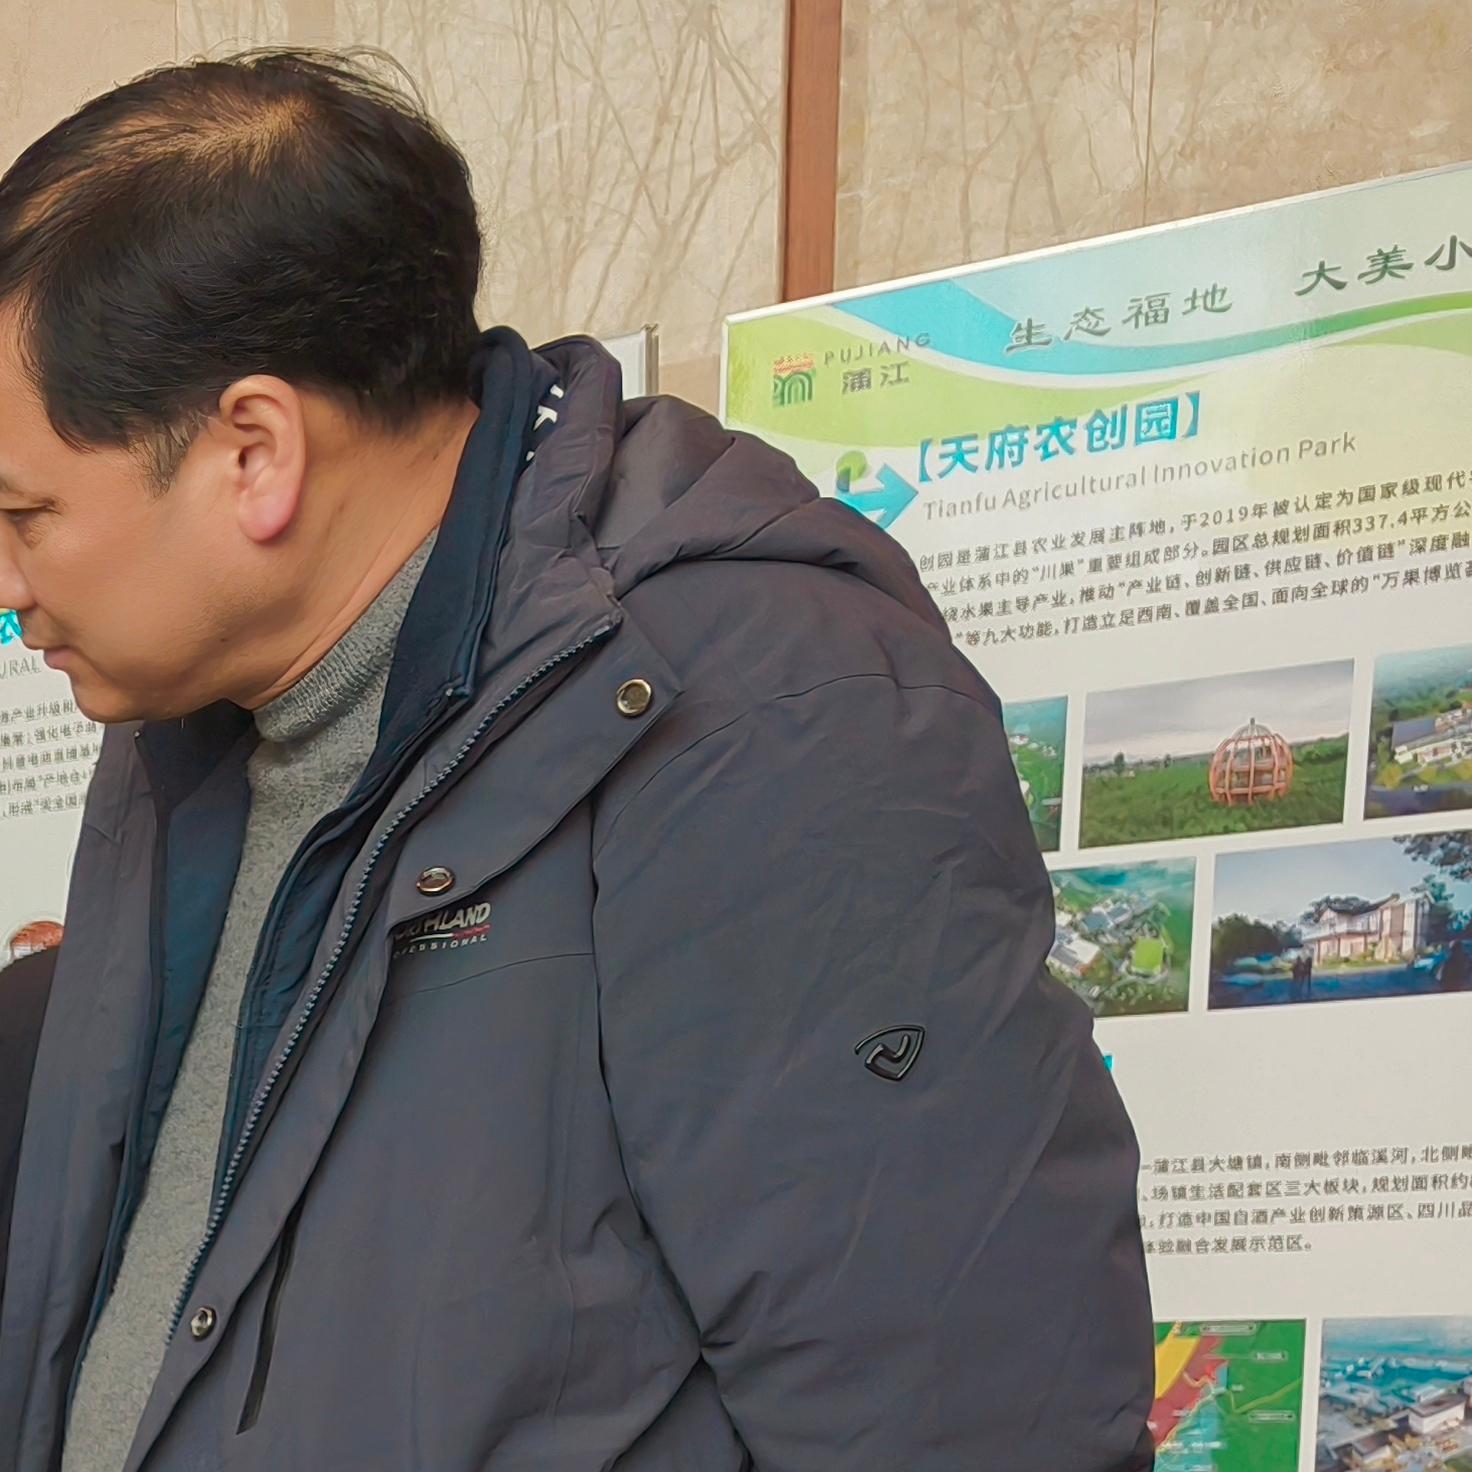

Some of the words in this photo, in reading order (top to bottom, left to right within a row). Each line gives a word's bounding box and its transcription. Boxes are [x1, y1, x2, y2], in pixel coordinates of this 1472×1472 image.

[824, 332, 932, 368] PUJIANG
[1003, 282, 1233, 355] 生态福地
[841, 361, 911, 396] 蒲江
[918, 391, 1201, 484] 【天府农创园】
[924, 490, 998, 522] Tianfu
[1002, 464, 1148, 511] Agricultural
[1153, 442, 1293, 485] Innovation
[1297, 430, 1358, 459] Park
